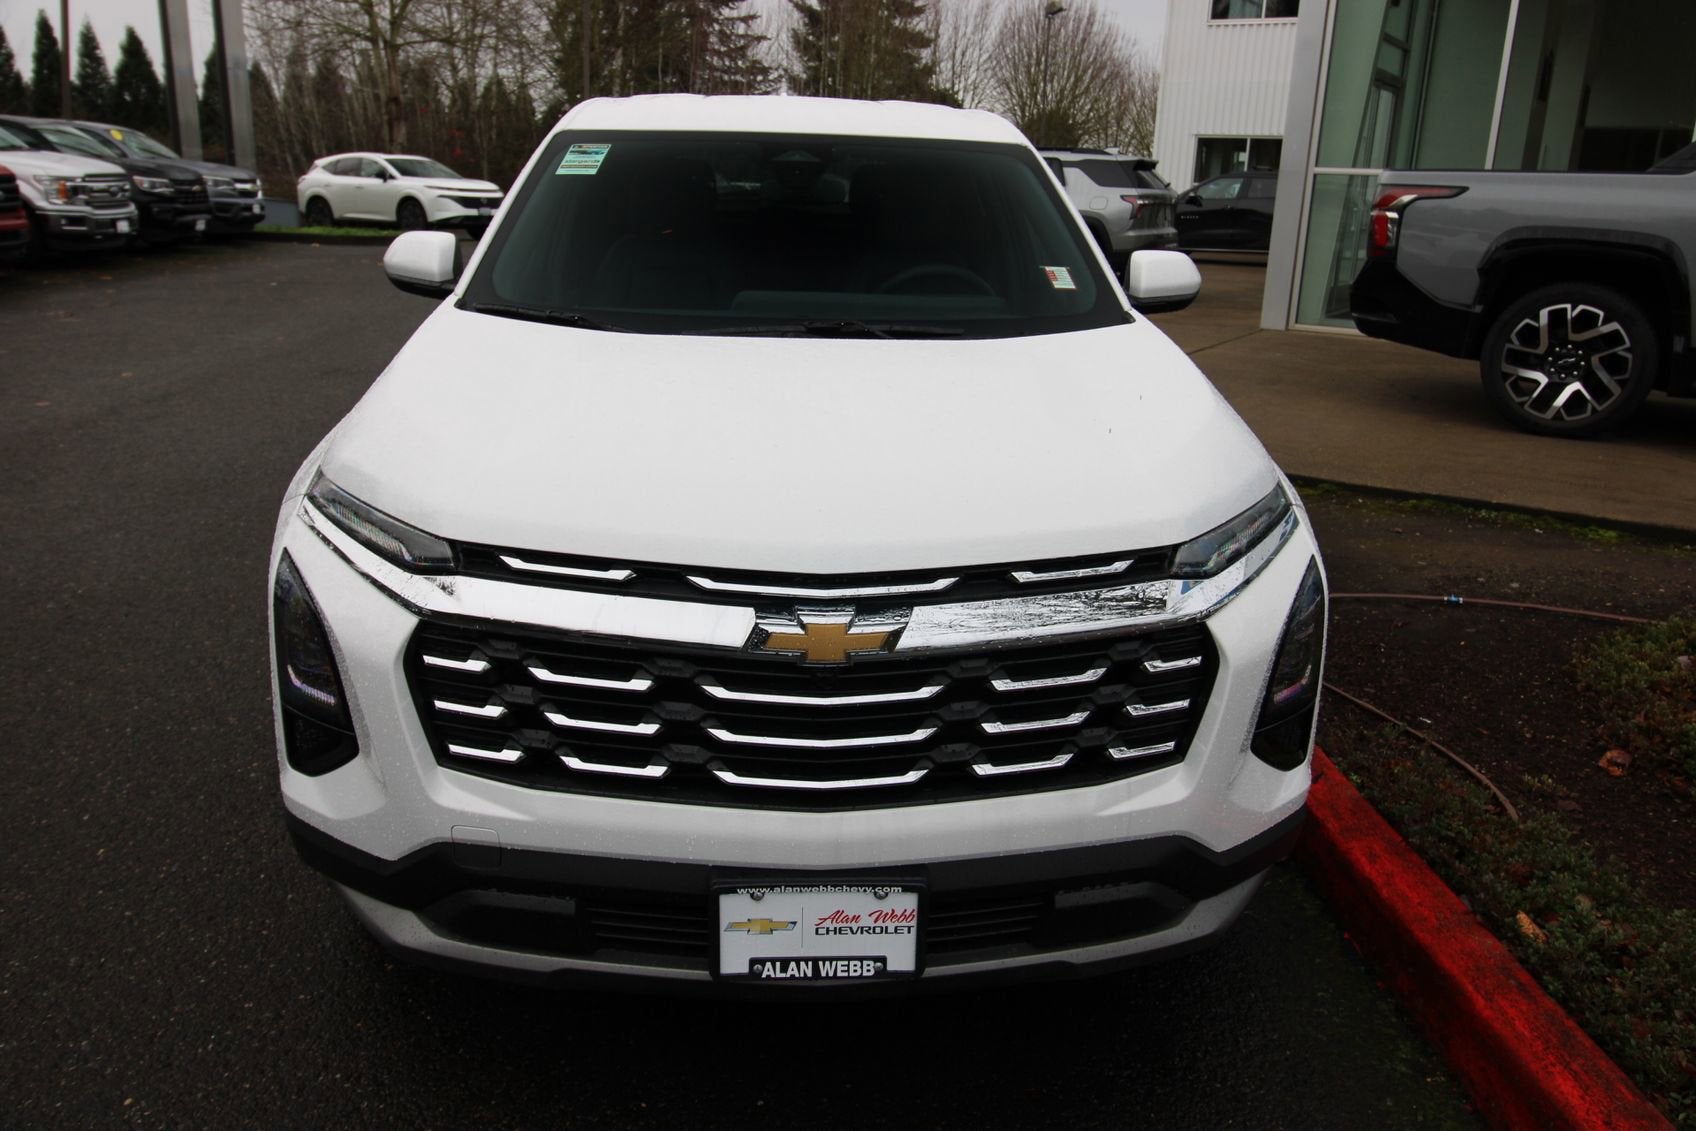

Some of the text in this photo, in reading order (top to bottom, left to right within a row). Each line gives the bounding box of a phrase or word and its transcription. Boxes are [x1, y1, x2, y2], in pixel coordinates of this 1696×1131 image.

[737, 885, 902, 894] www.alanwebbchevy.com
[814, 908, 916, 926] Alan Webb
[814, 925, 916, 936] CHEVROLET
[761, 960, 876, 978] ALAN WEBB
